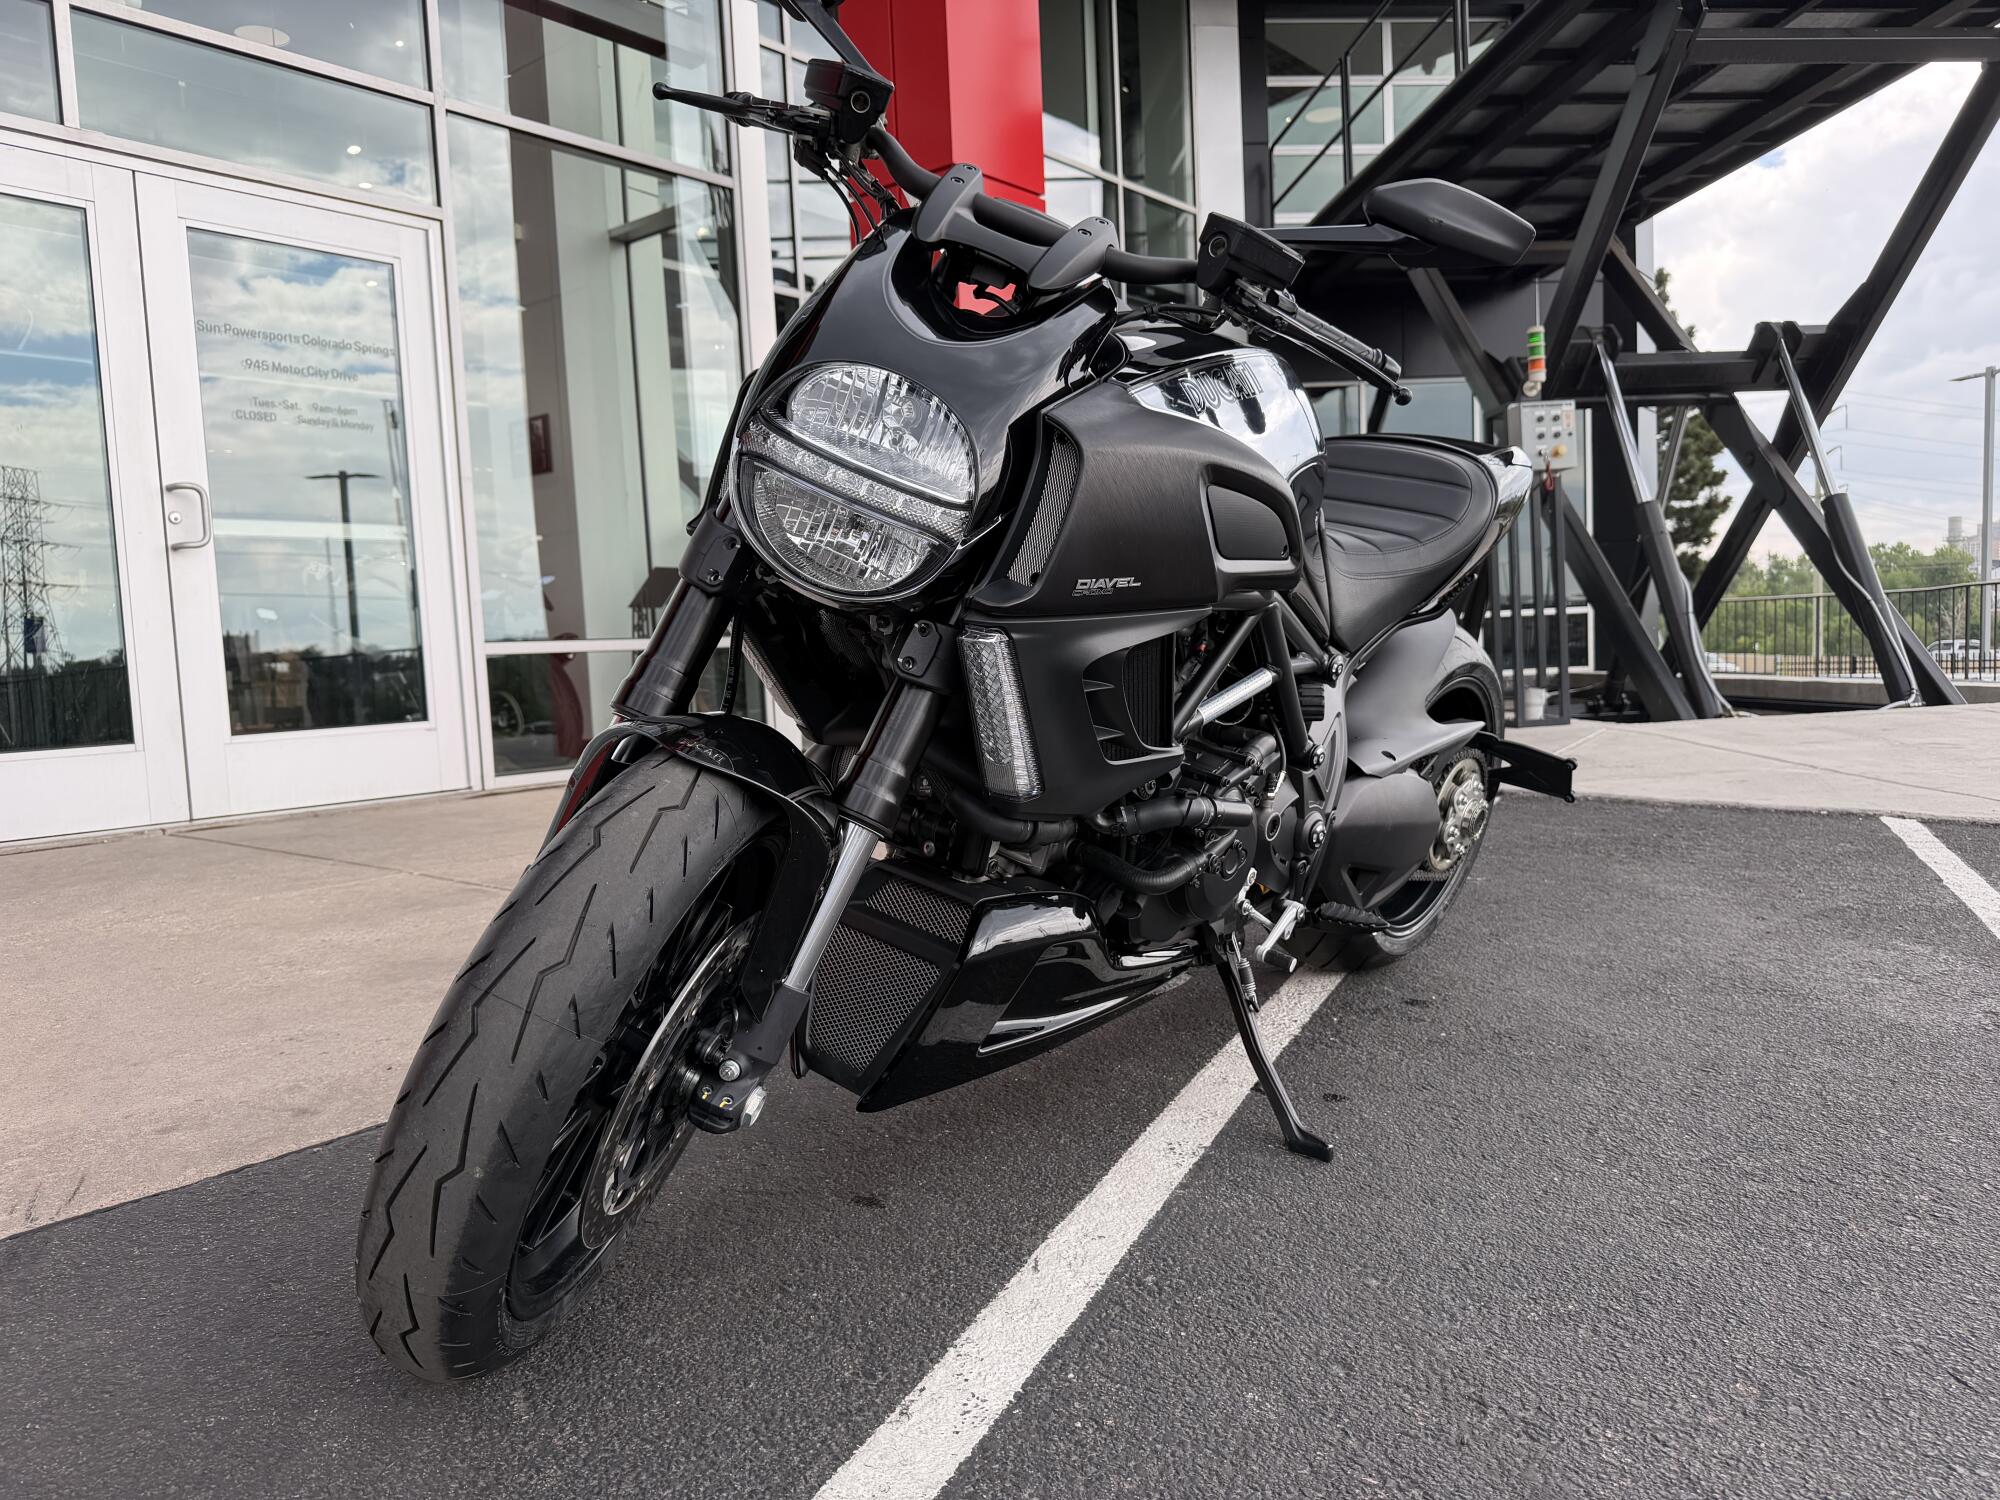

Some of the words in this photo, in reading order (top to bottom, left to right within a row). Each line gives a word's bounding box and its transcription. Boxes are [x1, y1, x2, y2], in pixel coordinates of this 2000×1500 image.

[196, 320, 221, 335] Sun
[224, 323, 300, 345] Powersports
[302, 334, 352, 351] Colorado
[354, 340, 395, 358] Springs
[244, 358, 269, 371] 945
[271, 361, 305, 376] Motor
[307, 365, 329, 380] City
[331, 368, 358, 382] Drive
[1178, 361, 1264, 417] DUCATI
[235, 409, 277, 422] CLOSED
[296, 415, 330, 428] Sunday
[340, 419, 374, 431] Monday
[1075, 577, 1142, 590] DIAVEL
